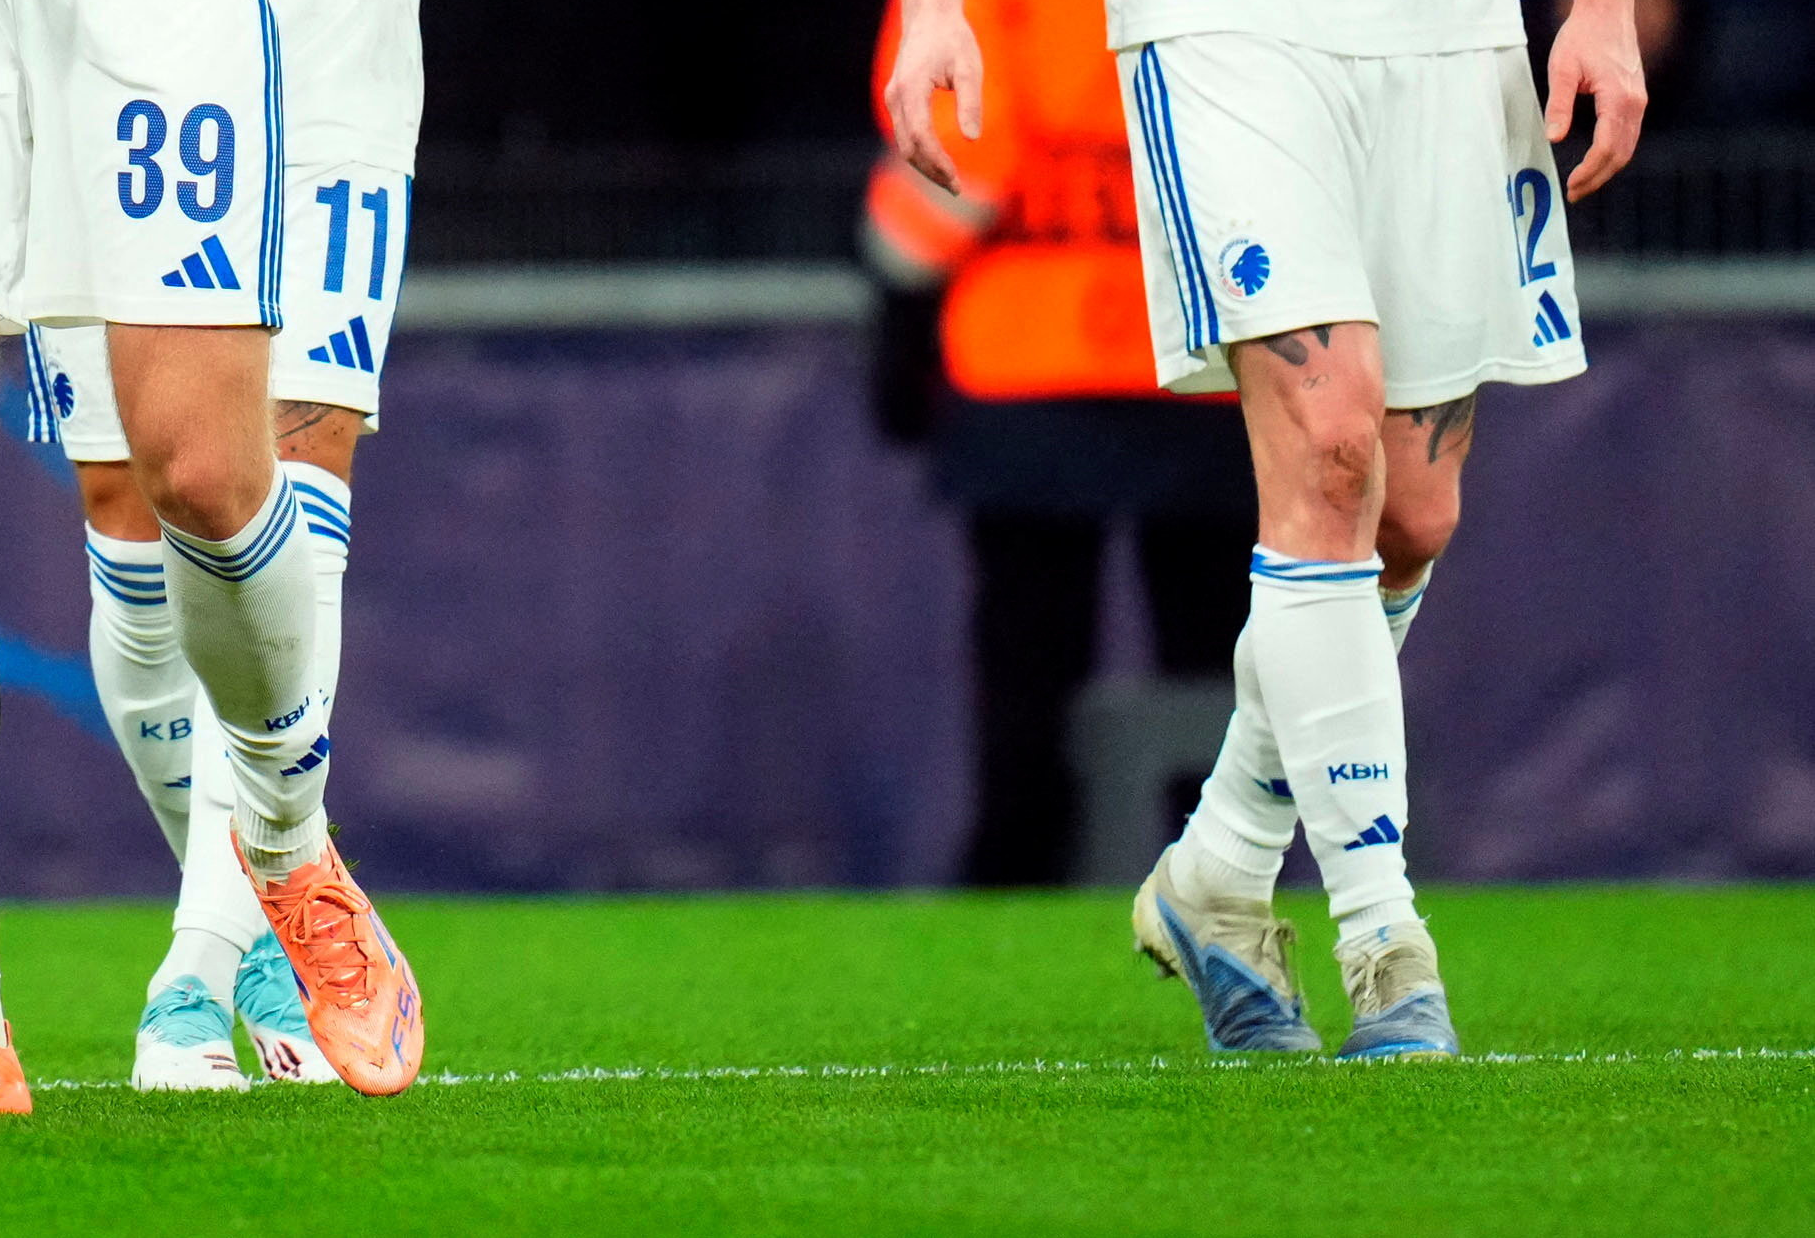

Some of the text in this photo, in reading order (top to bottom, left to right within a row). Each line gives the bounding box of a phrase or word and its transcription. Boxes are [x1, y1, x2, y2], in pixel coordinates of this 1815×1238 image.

[117, 99, 235, 223] 39
[316, 179, 388, 301] 11
[1328, 763, 1388, 784] KBH
